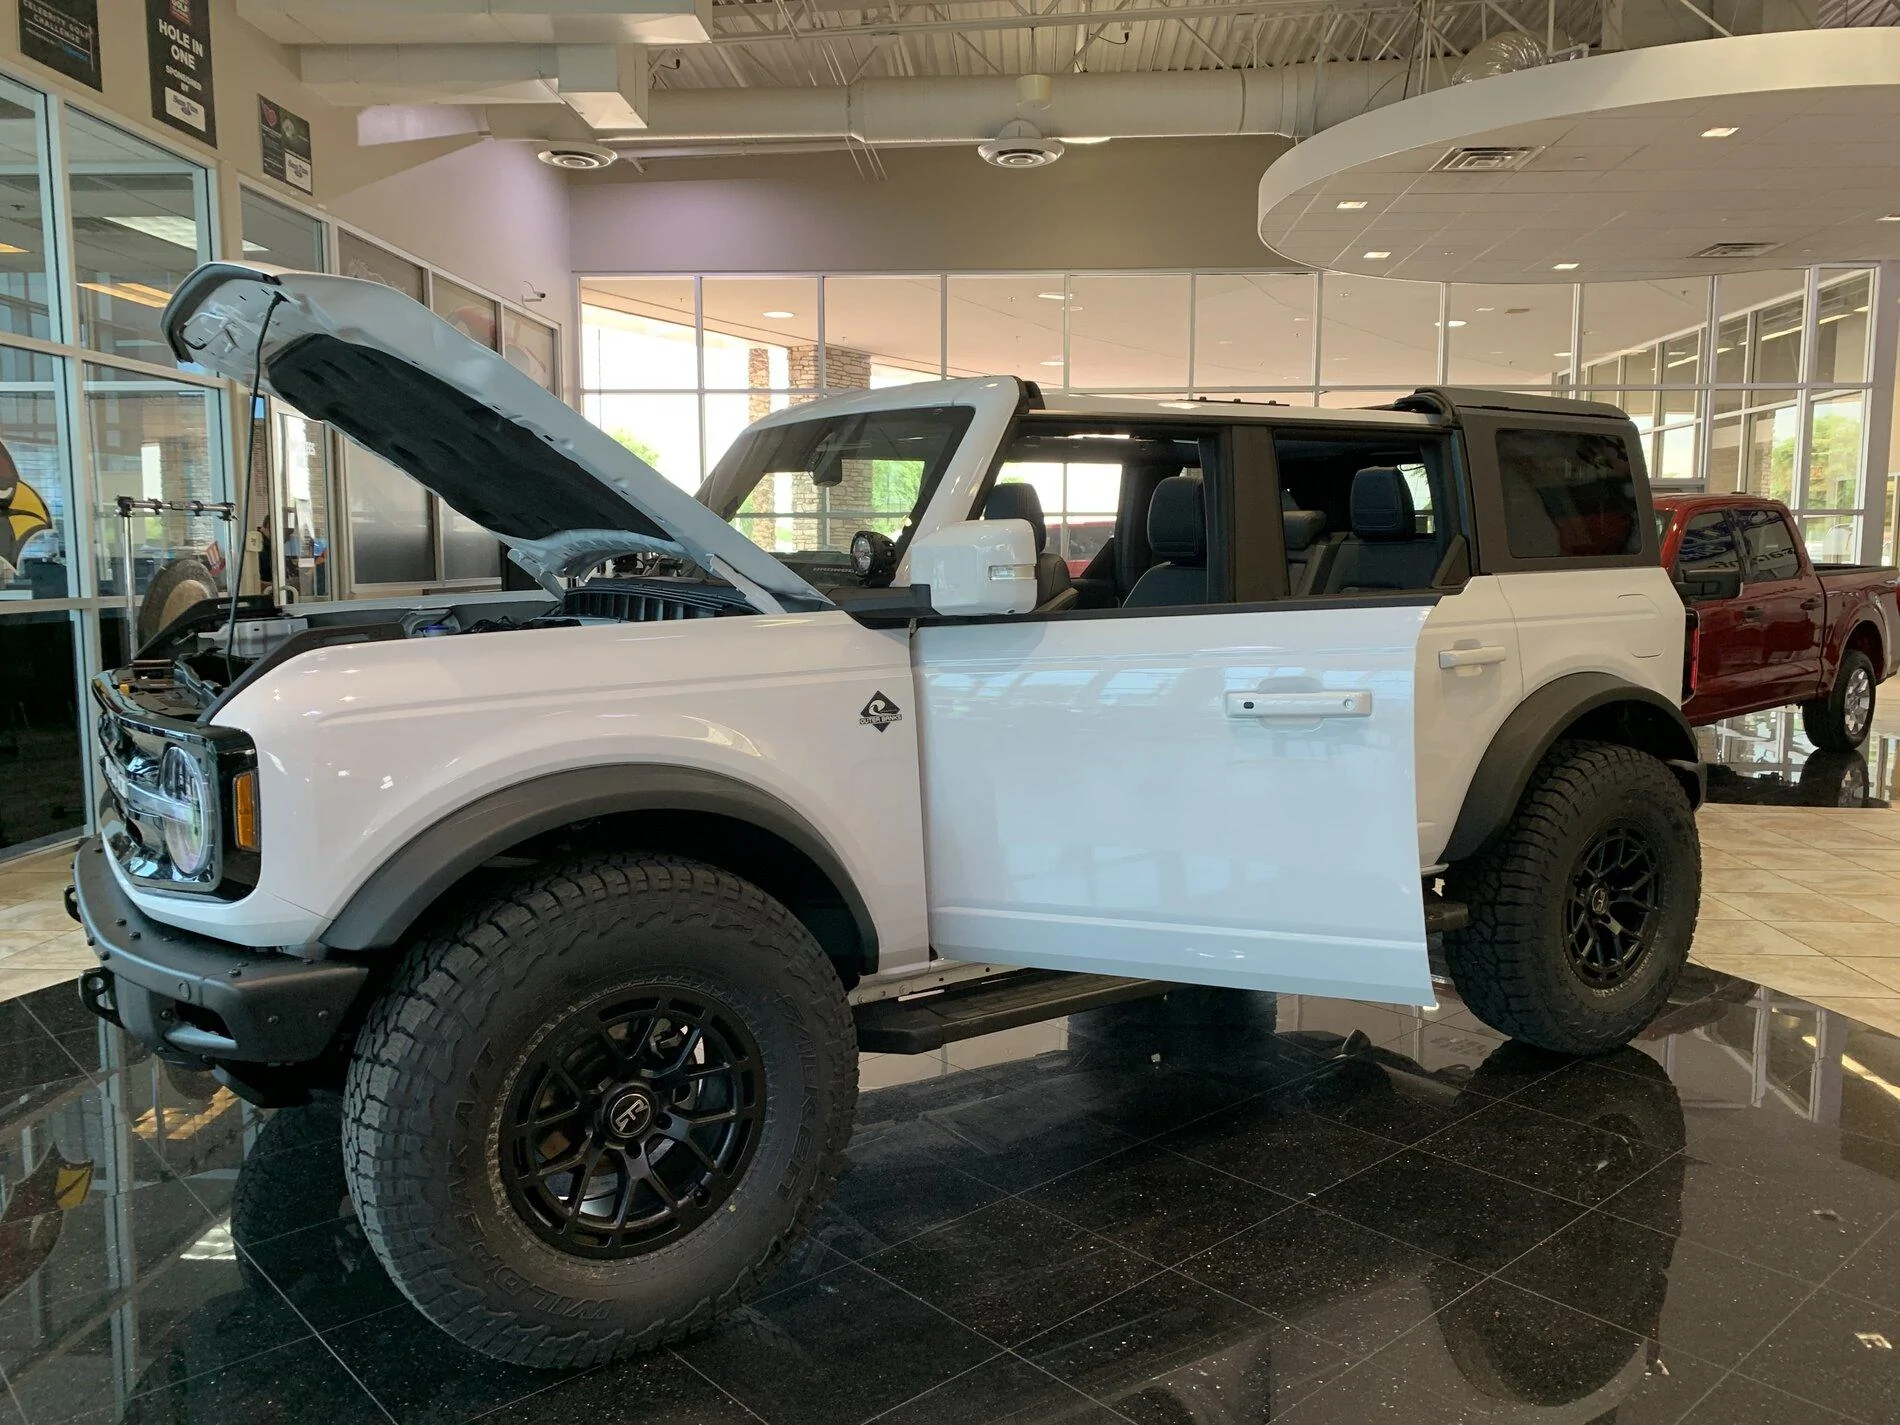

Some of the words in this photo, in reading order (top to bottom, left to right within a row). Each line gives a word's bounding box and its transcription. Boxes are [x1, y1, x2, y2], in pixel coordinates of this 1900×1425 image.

[33, 13, 80, 44] CHALLENGE
[158, 18, 191, 50] HOLE
[192, 38, 203, 58] IN
[170, 44, 196, 71] ONE
[165, 64, 202, 91] SPONSORED
